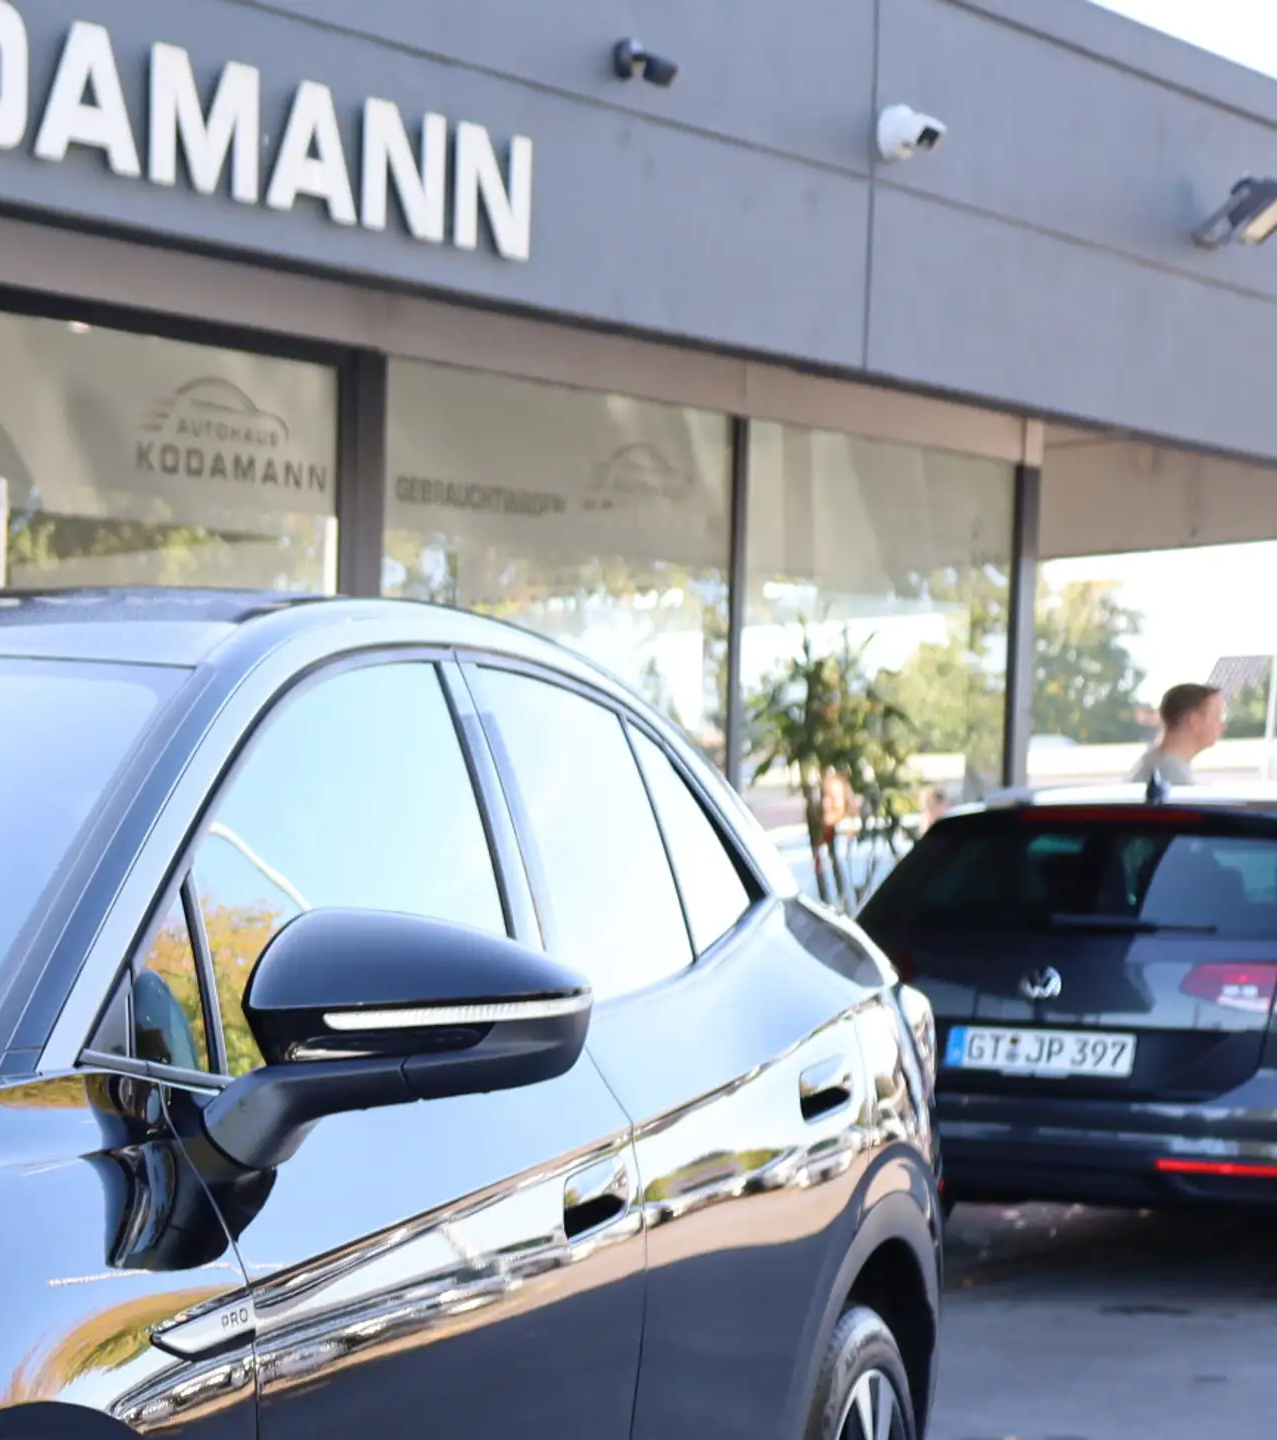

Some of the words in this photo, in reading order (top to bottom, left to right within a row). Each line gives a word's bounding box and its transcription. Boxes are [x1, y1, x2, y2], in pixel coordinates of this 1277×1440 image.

[176, 417, 279, 446] AUTOHAUS
[135, 441, 327, 492] KODAMANN
[966, 1033, 1007, 1061] GT
[1025, 1036, 1065, 1064] JP
[1070, 1039, 1129, 1069] 397
[220, 1307, 249, 1331] PRO
